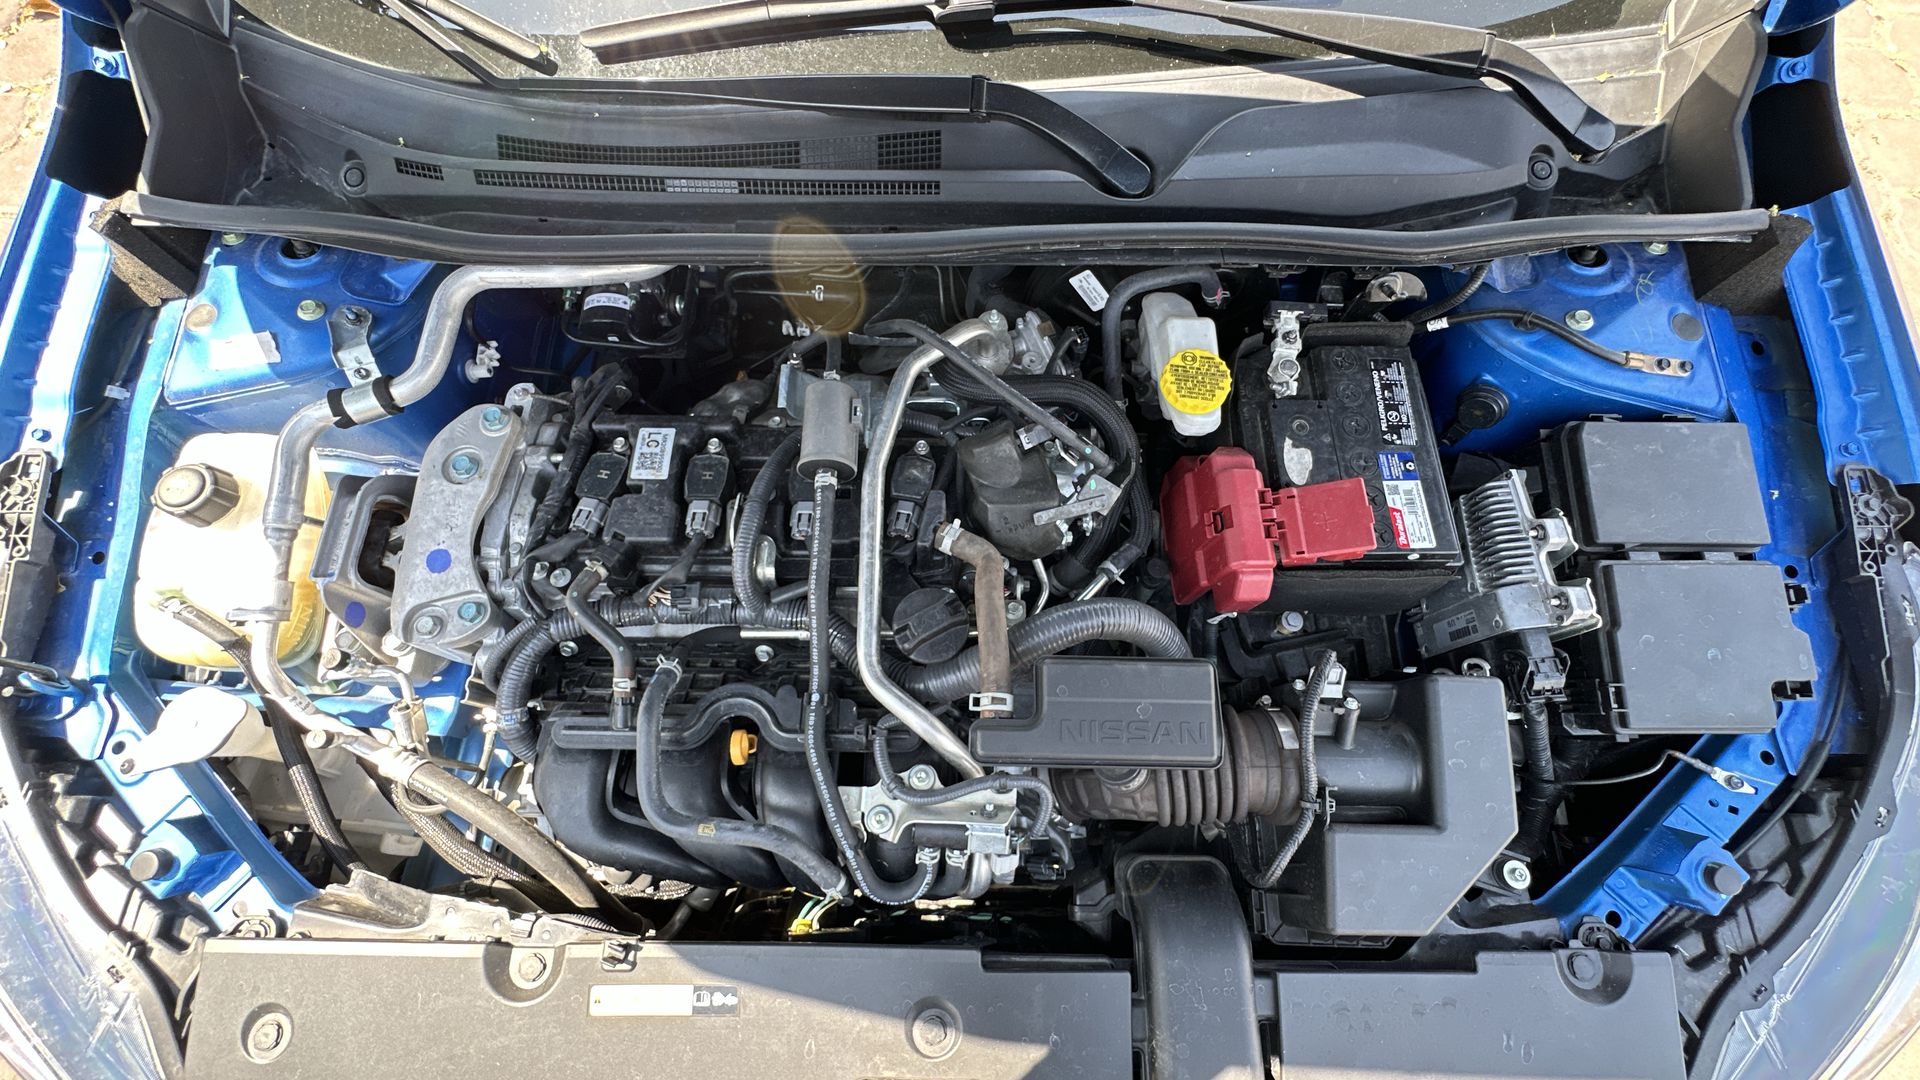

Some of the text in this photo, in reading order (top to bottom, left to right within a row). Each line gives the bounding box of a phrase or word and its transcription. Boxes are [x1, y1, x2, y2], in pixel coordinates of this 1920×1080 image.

[1372, 370, 1388, 431] PELIGRO/VENENO
[646, 432, 662, 449] LC
[1393, 511, 1408, 546] Duralast
[1059, 718, 1208, 745] NISSAN
